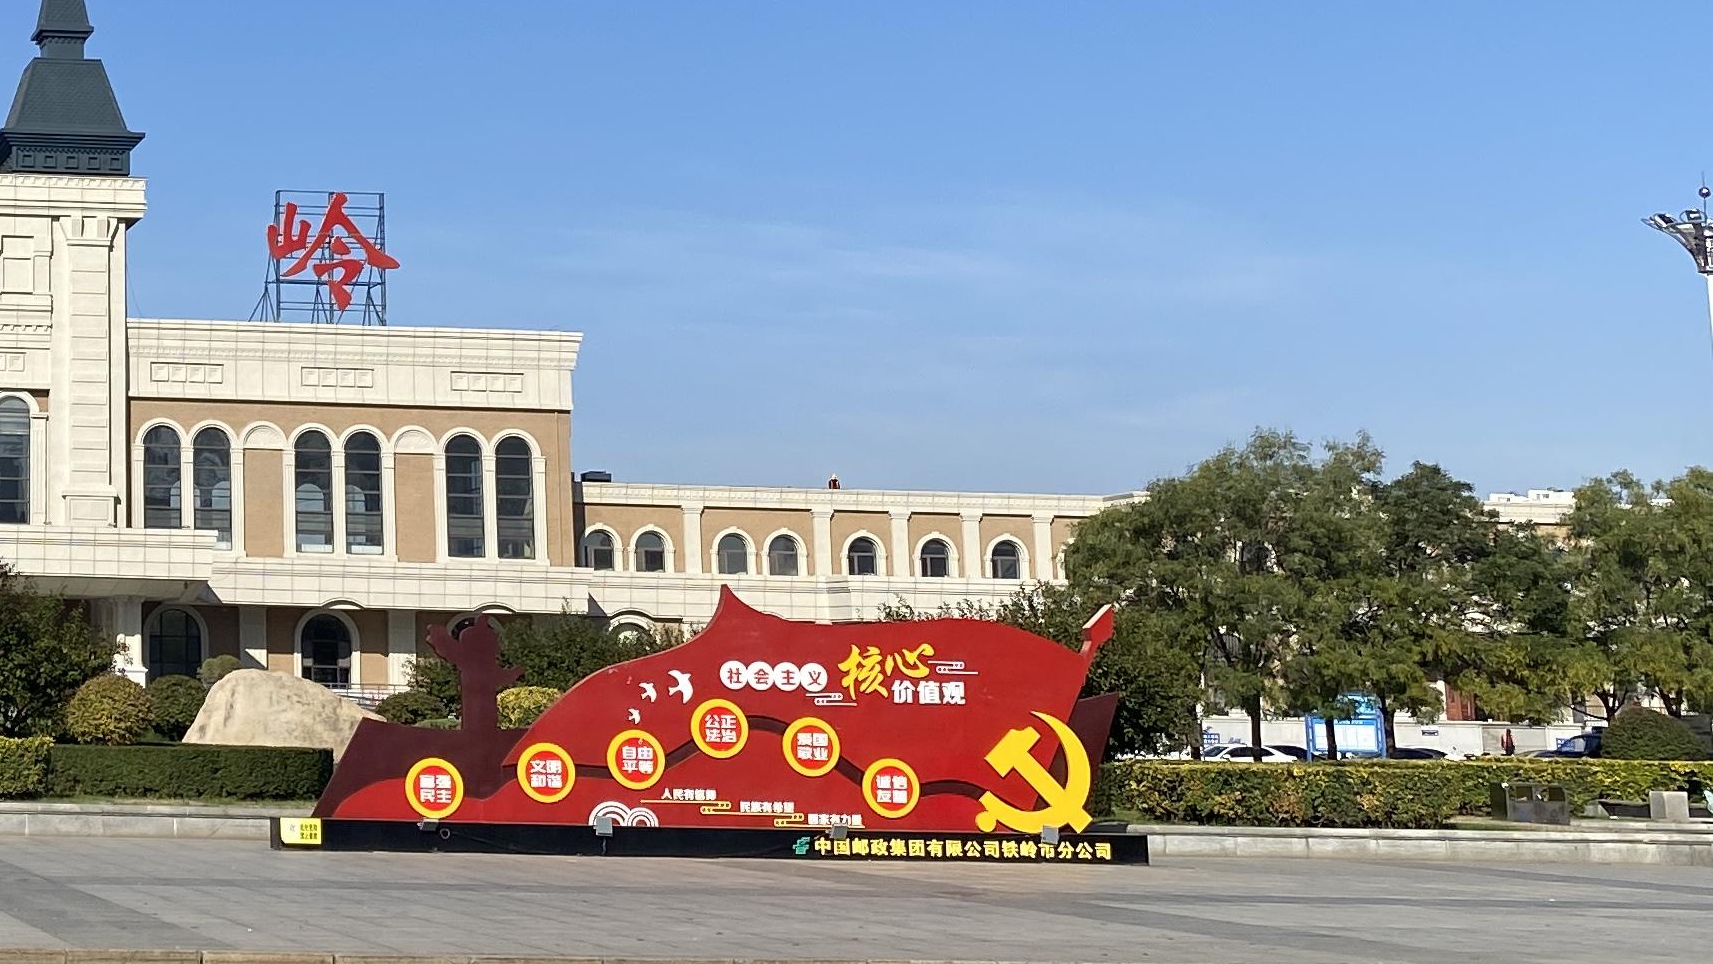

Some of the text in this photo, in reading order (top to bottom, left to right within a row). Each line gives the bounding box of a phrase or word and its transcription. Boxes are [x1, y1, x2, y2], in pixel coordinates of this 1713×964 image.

[267, 191, 401, 311] 岭
[726, 666, 823, 687] 社会主义
[838, 643, 935, 700] 核心
[891, 679, 967, 705] 价值观
[705, 714, 737, 728] 公正
[705, 728, 737, 743] 法治
[621, 745, 654, 760] 自由
[529, 759, 562, 774] 文明
[621, 760, 654, 775] 平等
[530, 774, 563, 788] 和谐
[419, 789, 452, 804] 民主
[814, 836, 1112, 860] 中国邮政集团有限公司铁岭市分公司
